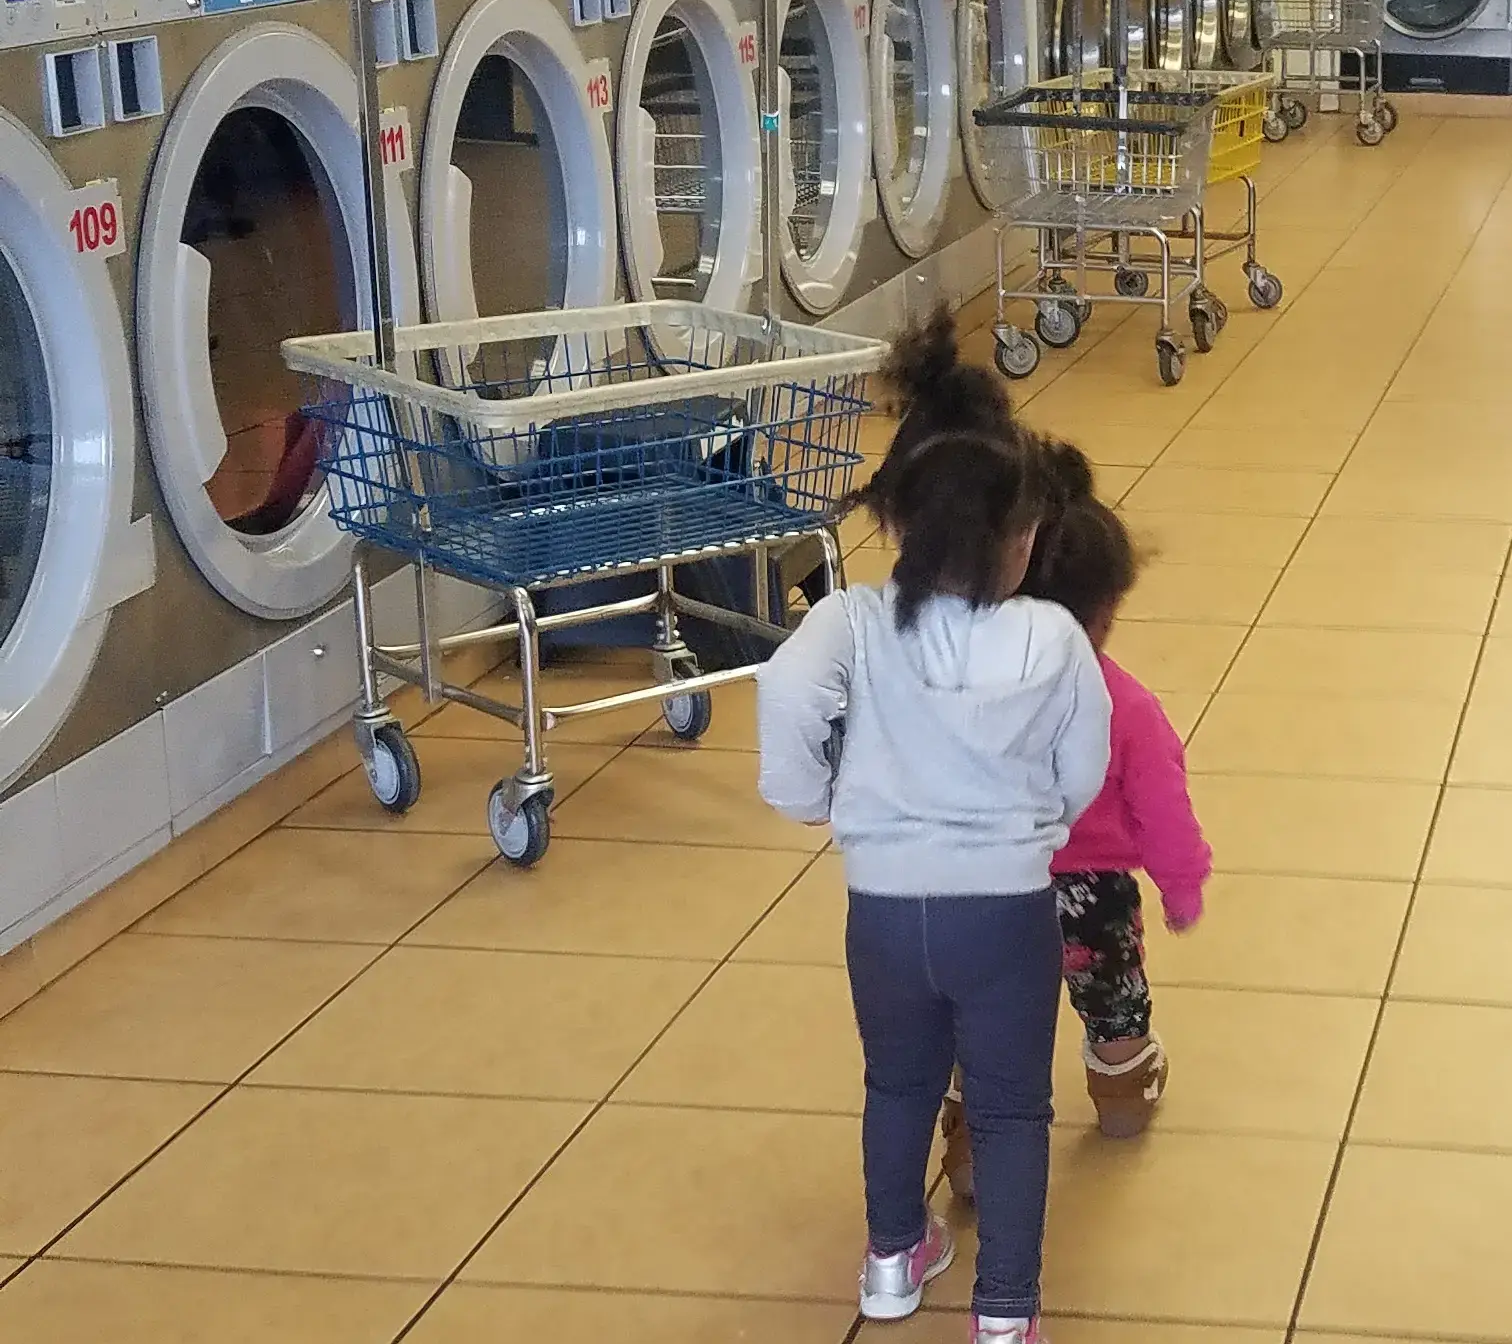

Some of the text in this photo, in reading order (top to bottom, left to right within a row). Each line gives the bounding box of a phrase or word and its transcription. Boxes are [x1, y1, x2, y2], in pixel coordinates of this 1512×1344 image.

[738, 35, 755, 64] 115
[586, 74, 609, 107] 113
[379, 125, 405, 165] 111
[69, 202, 117, 253] 109
